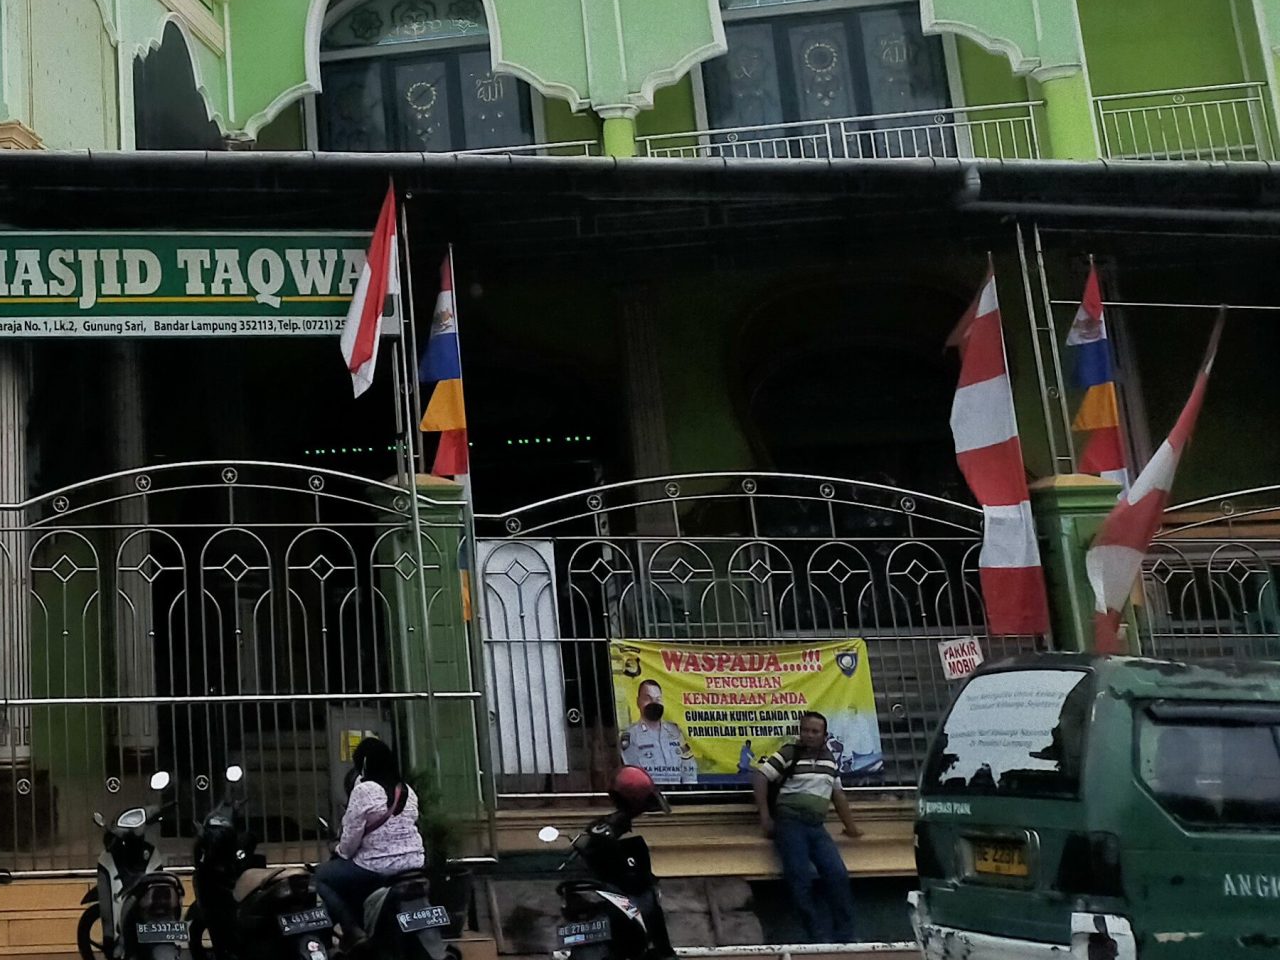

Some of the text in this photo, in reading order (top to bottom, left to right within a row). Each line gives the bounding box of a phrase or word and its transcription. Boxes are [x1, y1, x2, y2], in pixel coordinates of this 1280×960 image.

[24, 321, 41, 331] No.
[43, 321, 52, 333] 1,
[83, 321, 123, 334] Gunung
[124, 320, 147, 332] Sari,
[154, 320, 189, 331] Bandar
[191, 320, 237, 333] Lampung
[277, 320, 301, 333] Telp.
[302, 320, 333, 332] (0721)
[943, 641, 978, 660] PARKIR
[705, 676, 782, 689] PENCURIAN
[682, 692, 808, 705] KENDARAAN ANDA
[685, 710, 728, 722] GUNAKAN
[730, 710, 758, 722] KUNCI
[759, 710, 790, 722] GANDA
[687, 725, 737, 737] PARKIRLAH
[738, 726, 748, 736] DI
[749, 725, 784, 737] TEMPAT
